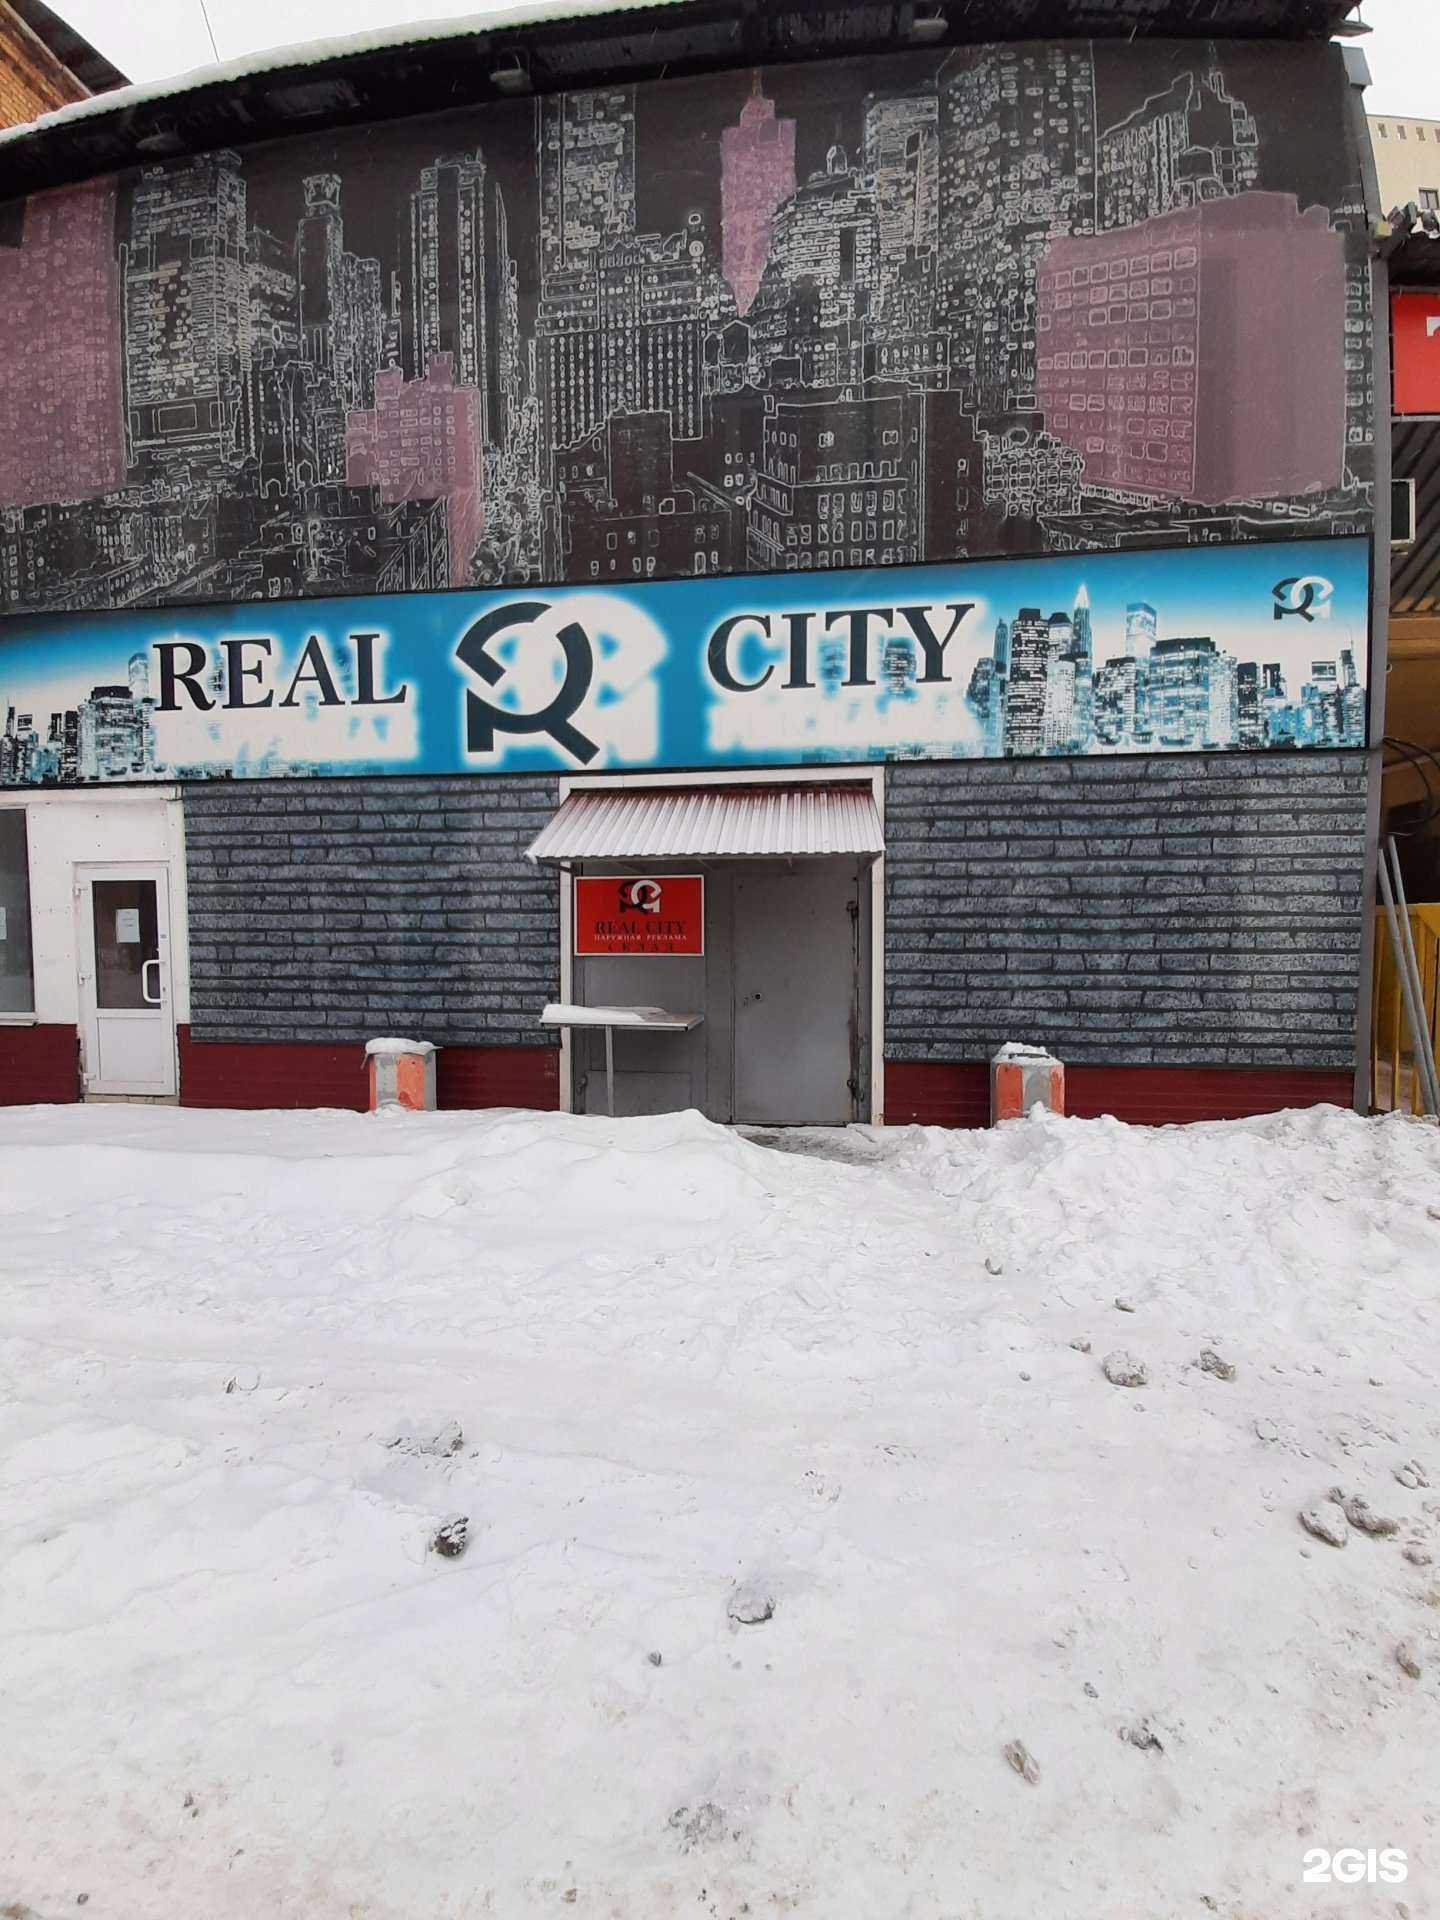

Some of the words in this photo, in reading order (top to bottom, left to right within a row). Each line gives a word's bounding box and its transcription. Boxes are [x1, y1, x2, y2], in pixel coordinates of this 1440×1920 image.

[153, 633, 407, 711] REAL
[707, 603, 975, 692] CITY
[595, 920, 638, 934] REAL
[645, 920, 686, 934] CITY
